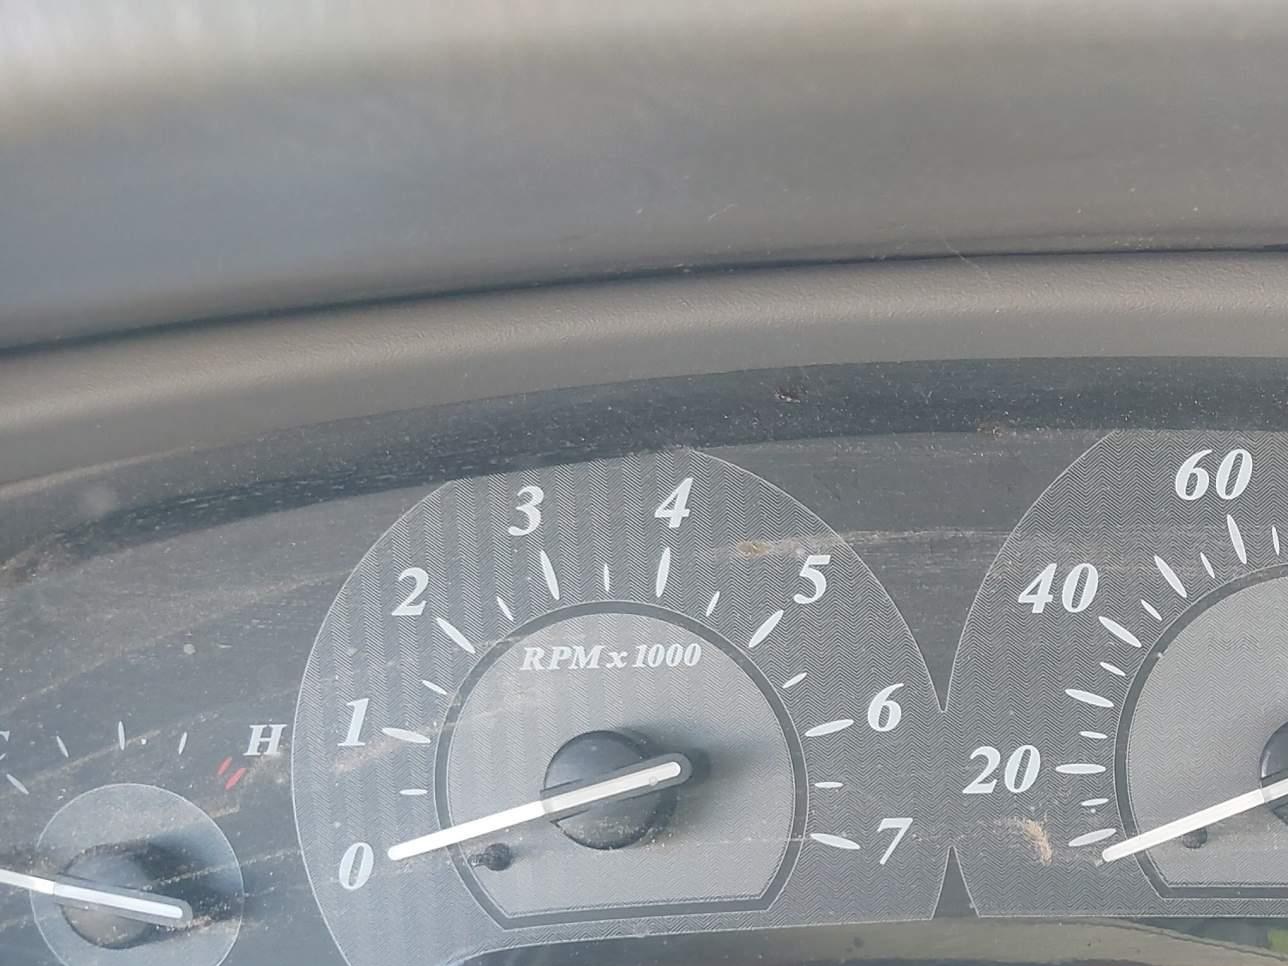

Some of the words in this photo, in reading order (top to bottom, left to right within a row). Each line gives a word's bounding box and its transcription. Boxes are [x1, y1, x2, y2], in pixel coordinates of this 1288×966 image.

[1174, 448, 1253, 501] 60
[507, 485, 544, 536] 3
[654, 477, 694, 529] 4
[391, 567, 429, 617] 2
[793, 554, 831, 605] 5
[1017, 562, 1099, 614] 40
[520, 646, 604, 671] RPM
[605, 651, 628, 669] x
[632, 643, 702, 668] 1000
[337, 698, 369, 747] 1
[867, 682, 904, 732] 6
[243, 723, 287, 757] H
[962, 744, 1041, 794] 20
[876, 817, 914, 865] 7
[338, 842, 374, 891] 0
